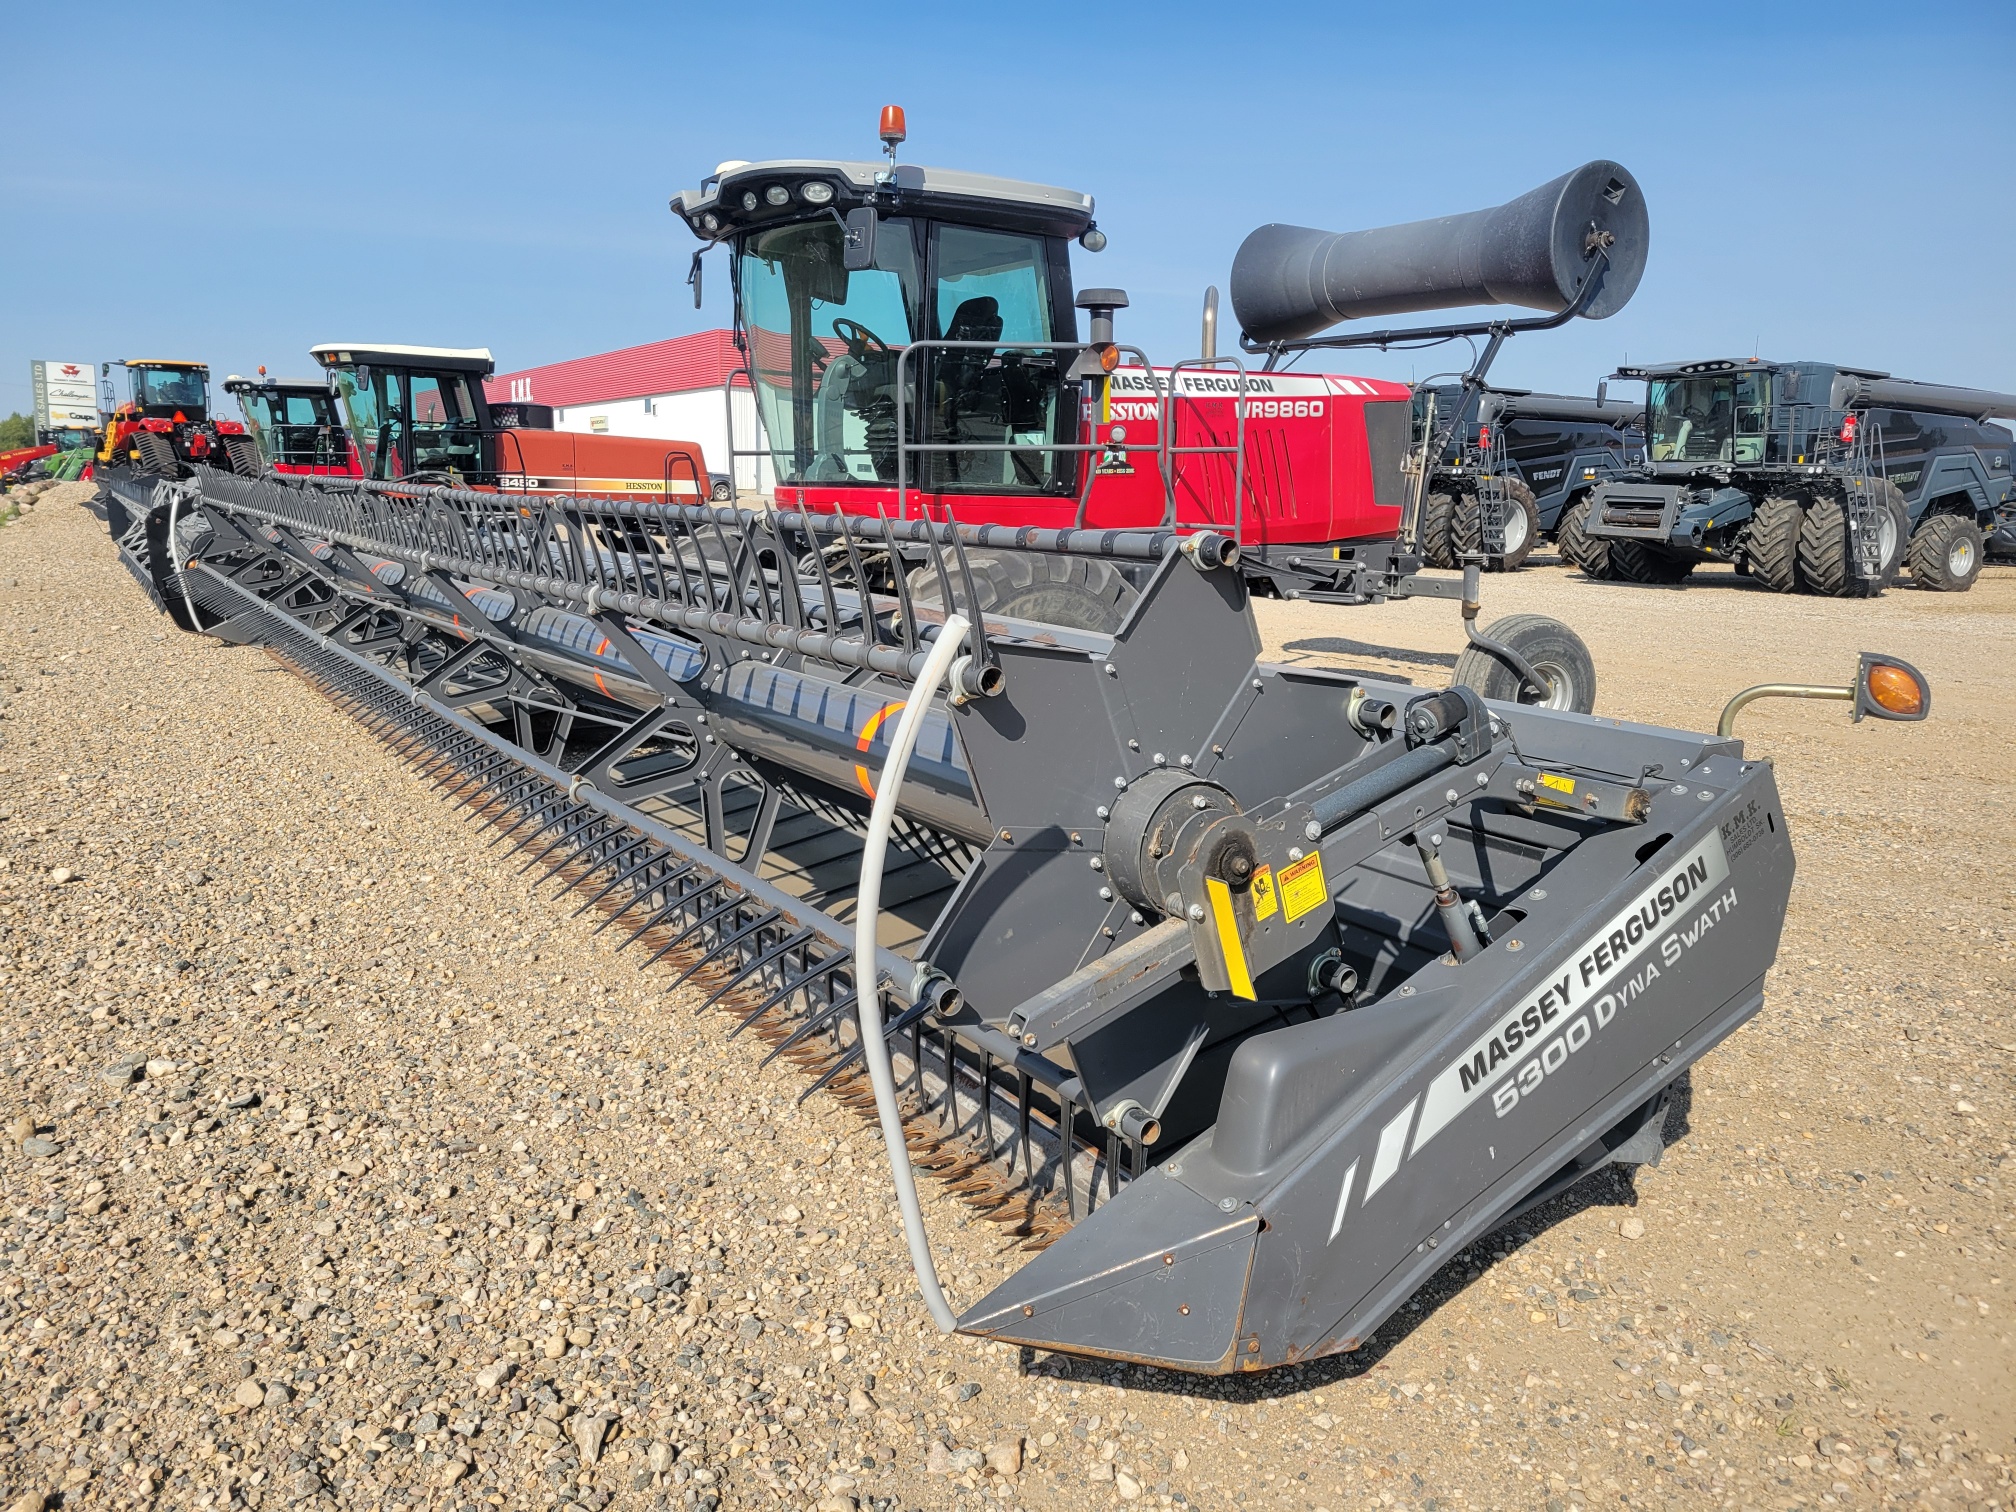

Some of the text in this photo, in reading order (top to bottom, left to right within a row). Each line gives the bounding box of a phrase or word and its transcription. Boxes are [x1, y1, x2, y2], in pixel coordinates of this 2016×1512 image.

[34, 364, 43, 381] LTD
[511, 377, 534, 402] K.M.K.
[1110, 376, 1274, 392] MASSEY FERGUSON
[35, 382, 45, 410] SALES
[49, 389, 90, 400] Challenger
[1082, 402, 1159, 421] HSSTON
[1234, 401, 1324, 418] WR9860
[1633, 454, 1640, 464] 9
[1994, 456, 2003, 468] 8
[500, 478, 538, 488] 8450
[1532, 468, 1563, 481] FENDT
[1888, 470, 1921, 484] FENDT
[625, 482, 663, 491] HESSTON
[1721, 799, 1761, 840] K.M.K.
[1729, 825, 1748, 844] SALES
[1290, 859, 1315, 877] WARNING
[1458, 855, 1709, 1093] MASSEY FERGUSON
[1492, 1014, 1592, 1119] 5300
